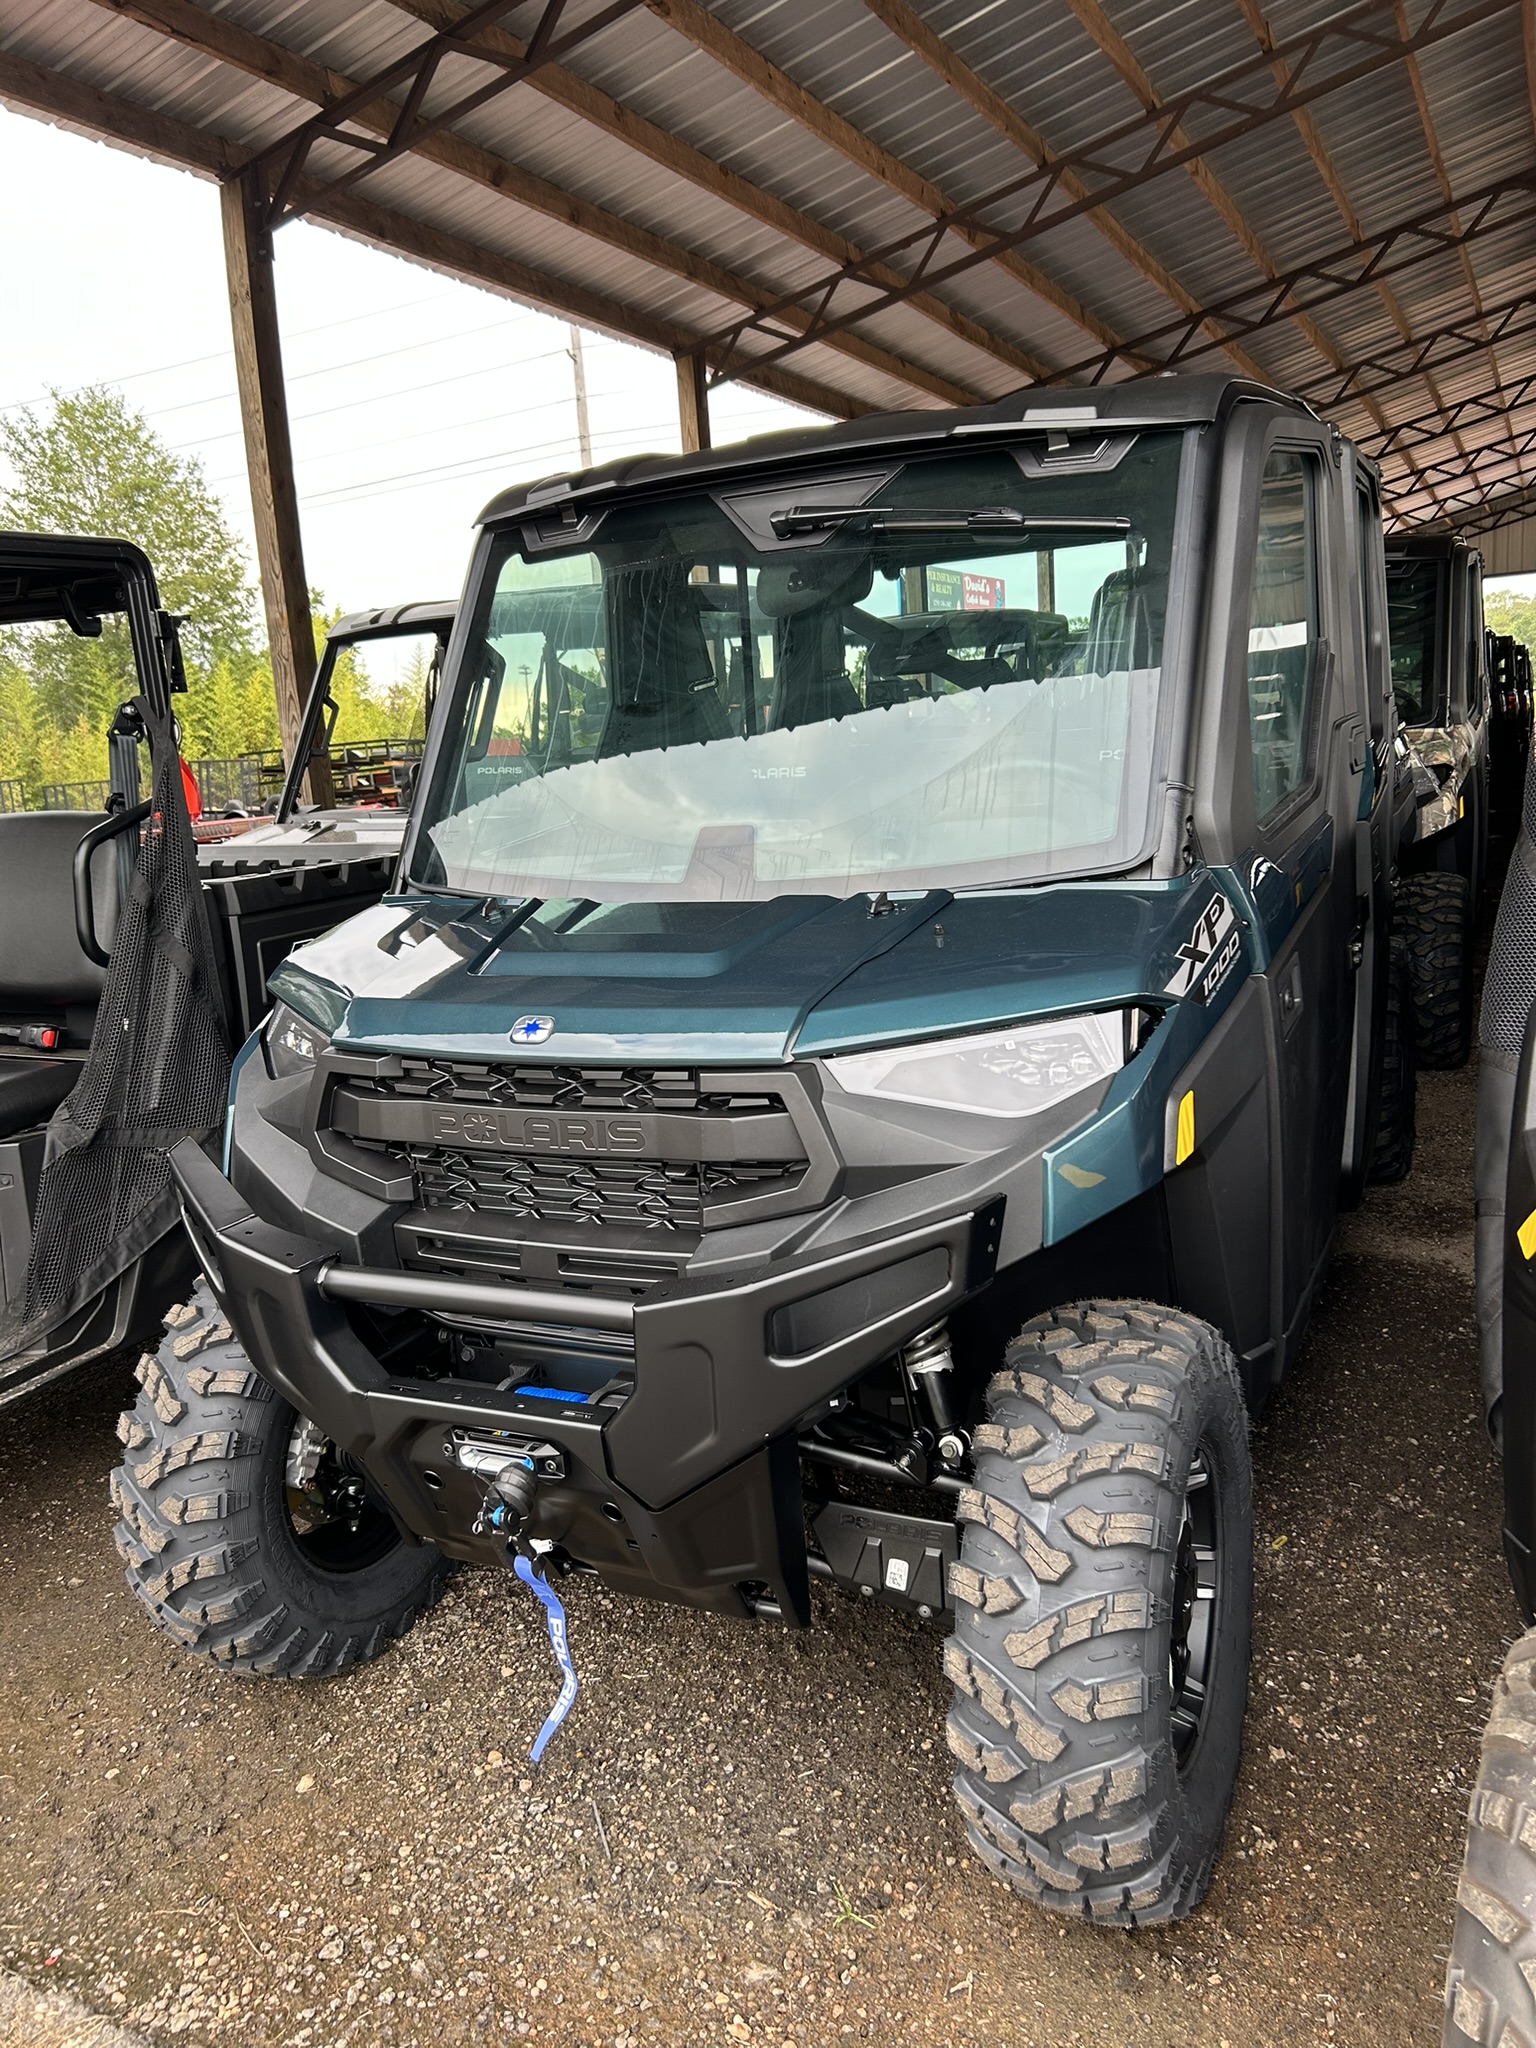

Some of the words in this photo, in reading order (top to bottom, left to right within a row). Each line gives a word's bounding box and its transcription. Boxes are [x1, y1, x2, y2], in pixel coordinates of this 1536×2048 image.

[937, 572, 961, 585] INSURANCE
[964, 576, 990, 594] David's
[477, 766, 523, 775] POLARIS
[1170, 891, 1229, 996] XP
[1203, 931, 1240, 996] 1000
[432, 1109, 646, 1152] POLARIS
[841, 1512, 944, 1545] POLARIS
[549, 1616, 576, 1723] POLARIS
